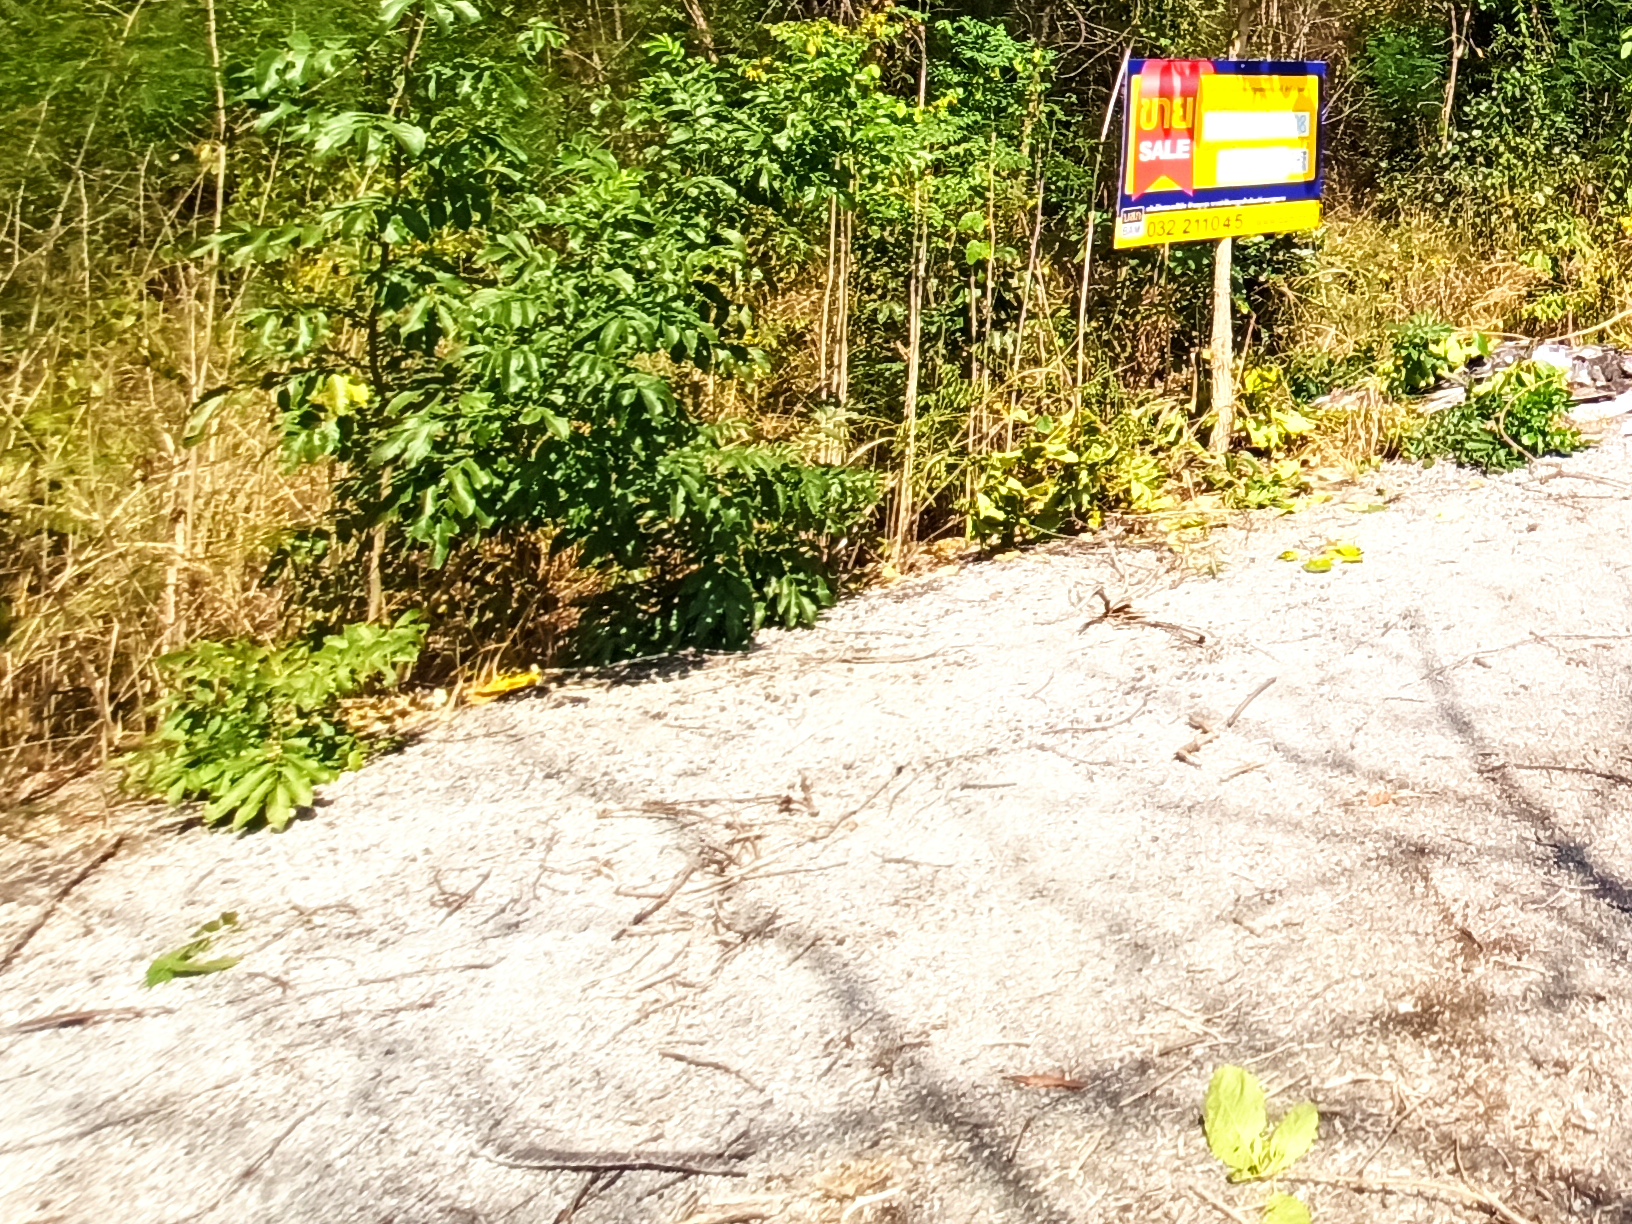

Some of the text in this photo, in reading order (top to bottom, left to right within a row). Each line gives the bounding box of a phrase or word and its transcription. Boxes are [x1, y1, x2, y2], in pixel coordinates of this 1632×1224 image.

[1140, 97, 1193, 130] ขาย
[1139, 139, 1191, 162] SALE
[1147, 219, 1176, 238] 032
